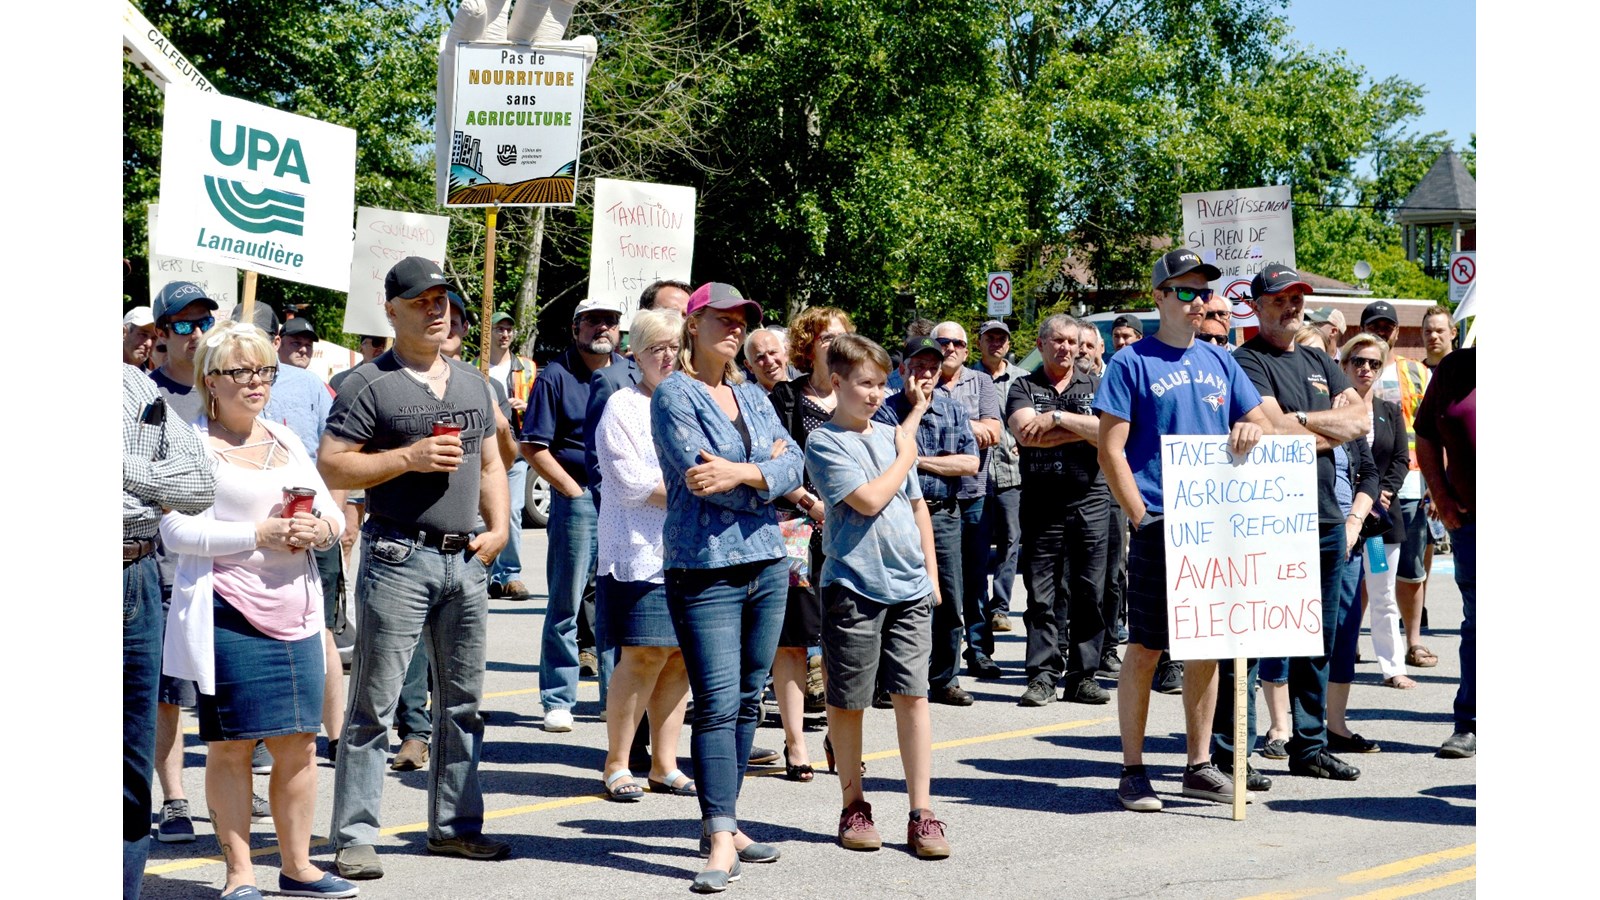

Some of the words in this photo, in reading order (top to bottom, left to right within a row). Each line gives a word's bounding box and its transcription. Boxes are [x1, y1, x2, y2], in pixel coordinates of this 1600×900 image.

[147, 28, 218, 94] CALFEUTRA
[501, 50, 524, 65] Pas
[530, 51, 545, 65] de
[468, 69, 574, 87] NOURRITURE
[506, 94, 536, 106] sans
[466, 110, 572, 126] AGRICULTURE
[210, 119, 311, 184] UPA
[497, 144, 517, 155] UPA
[606, 201, 683, 229] TAXATION
[1197, 197, 1291, 219] AVERTISSEMENT
[369, 220, 435, 246] COUILLARD
[1188, 229, 1205, 249] SI
[1213, 226, 1243, 247] RIEN
[1249, 226, 1268, 243] DE
[197, 227, 304, 268] Lanaudière
[619, 234, 677, 262] FONCIERE
[191, 260, 205, 273] LE
[1219, 265, 1241, 278] AINE
[1150, 370, 1190, 397] BLUE
[1194, 370, 1227, 396] JAYS
[1166, 441, 1234, 467] TAXES
[1174, 476, 1304, 510] AGRICOLES...
[1171, 520, 1215, 547] UNE
[1229, 512, 1318, 539] REFONTE
[1175, 552, 1267, 591] AVANT
[1277, 561, 1308, 581] LES
[1174, 598, 1322, 640] ÉLECTIONS
